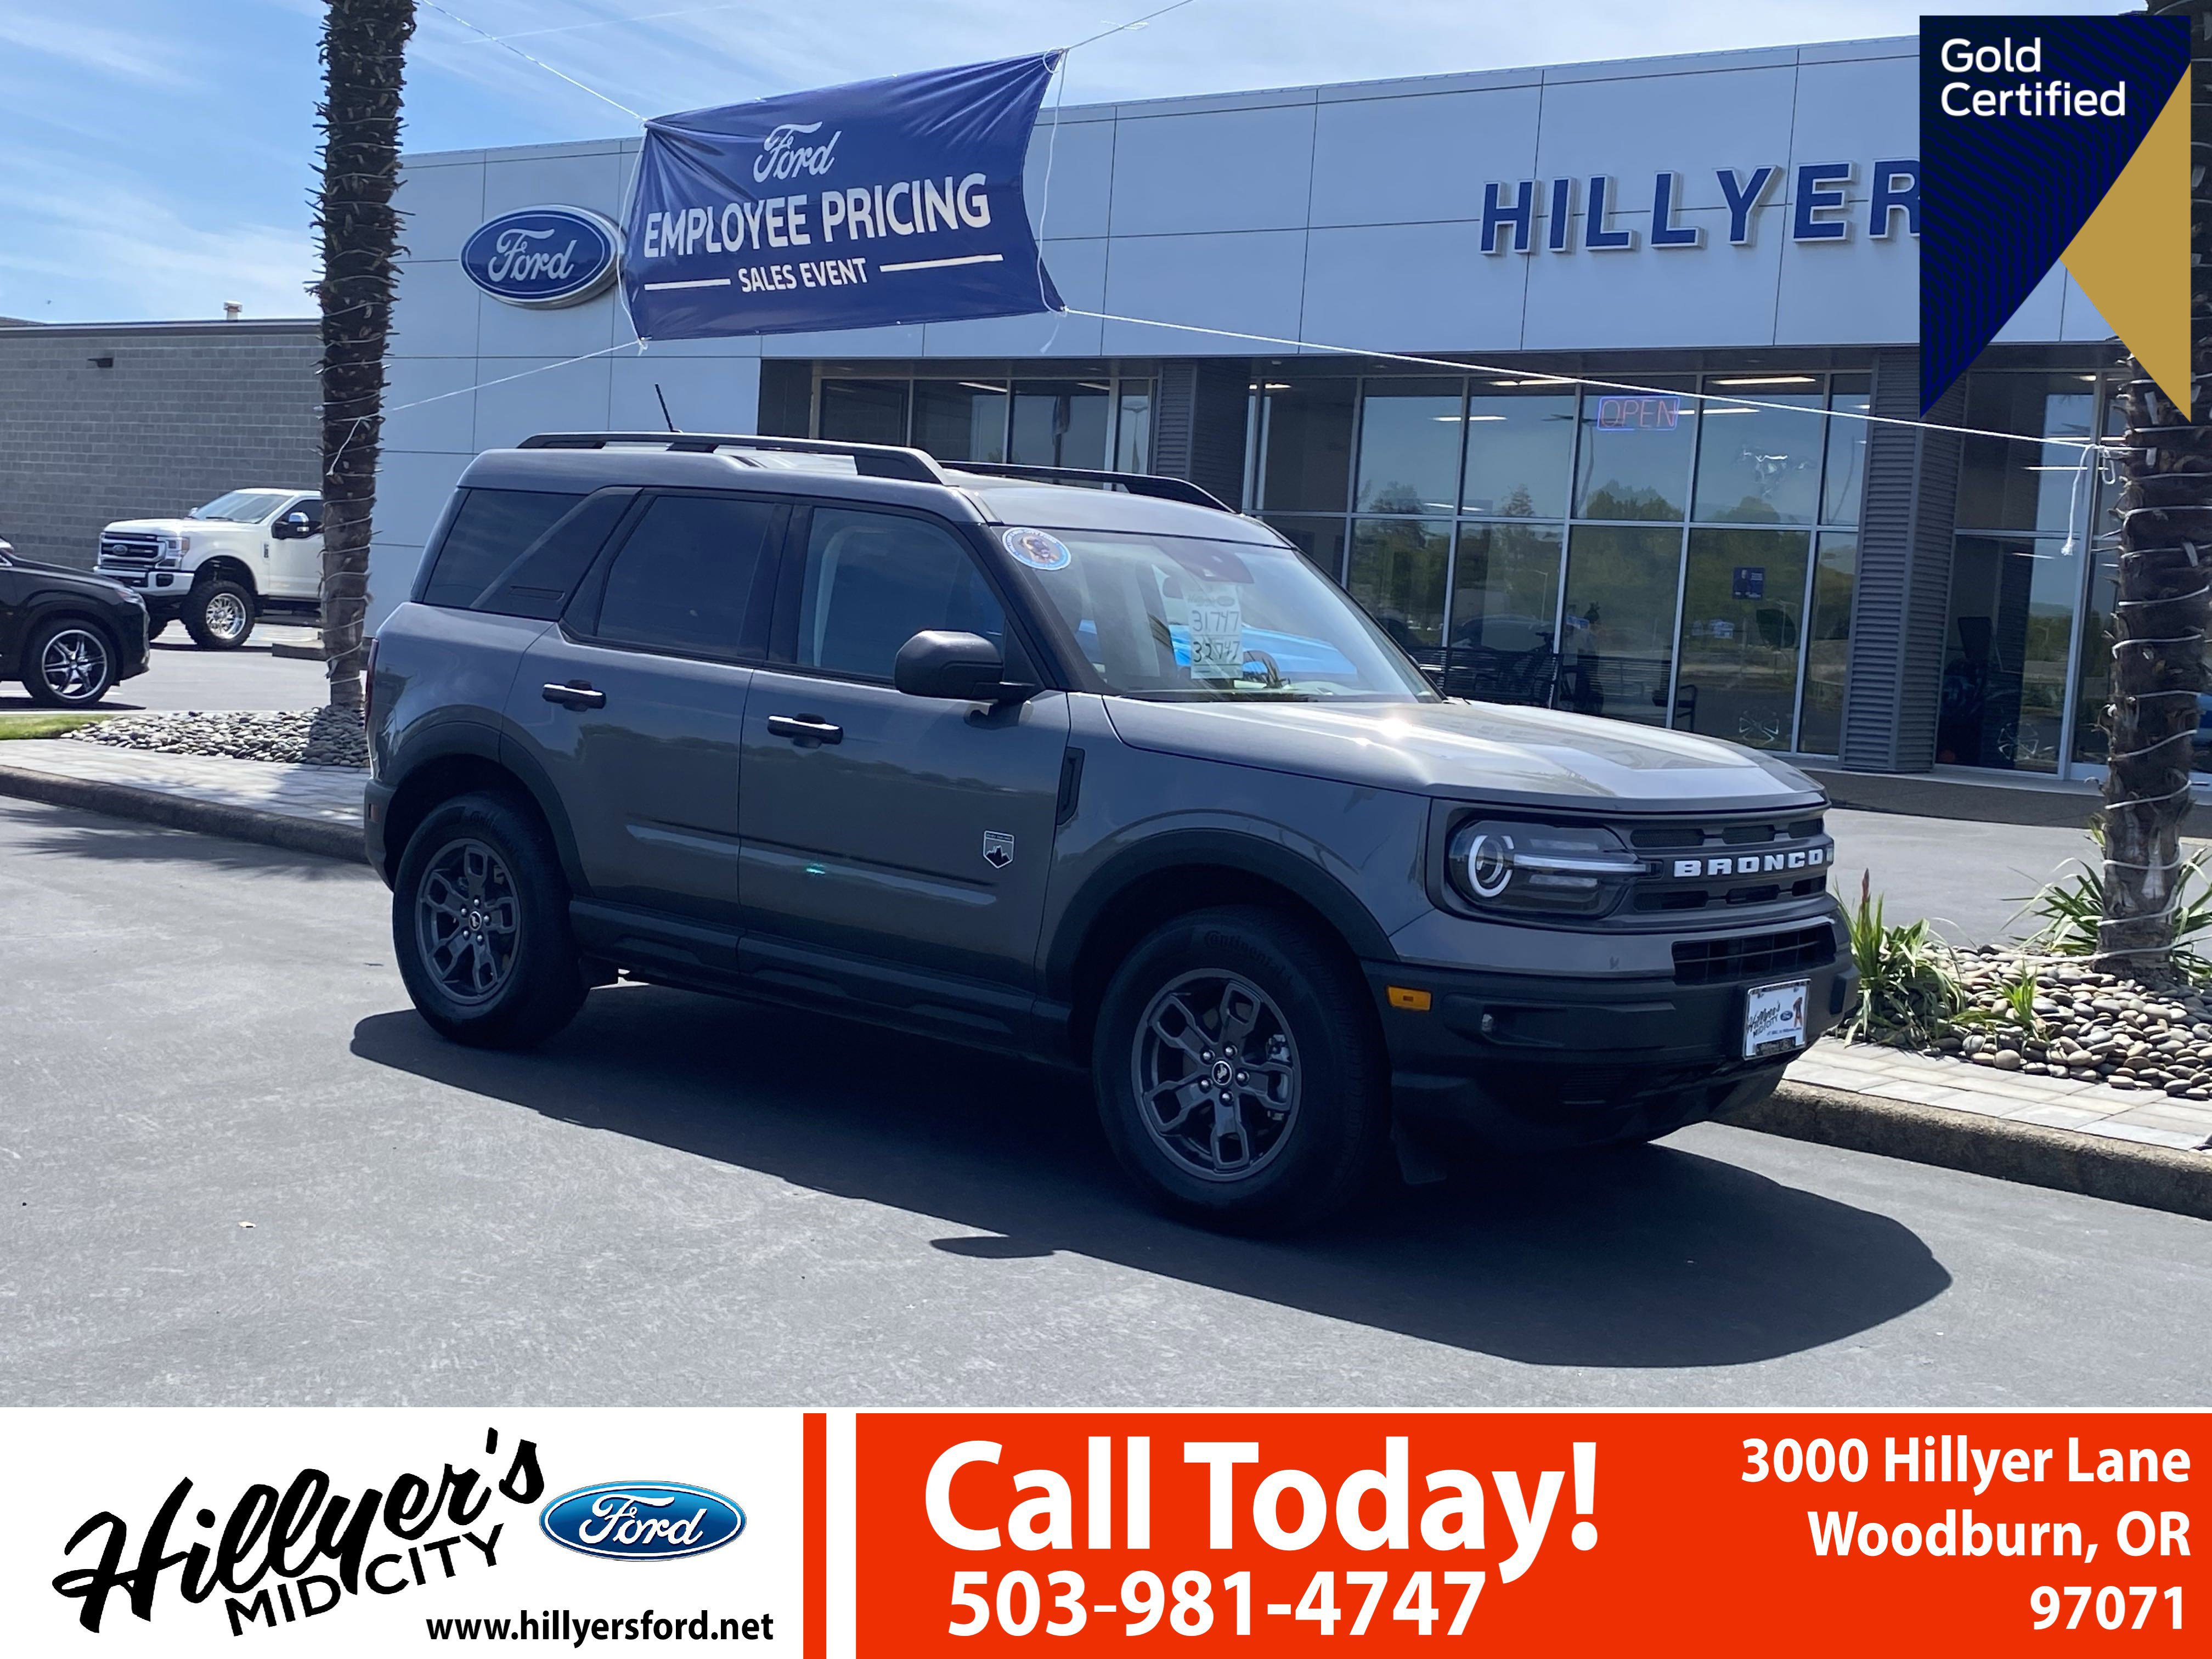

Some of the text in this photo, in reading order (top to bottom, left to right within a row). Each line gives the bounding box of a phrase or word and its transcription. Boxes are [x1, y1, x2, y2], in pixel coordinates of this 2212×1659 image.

[753, 121, 842, 183] Ford
[644, 172, 991, 258] EMPLOYEE PRICING
[1480, 157, 1920, 255] HILLYER
[488, 228, 577, 281] Ford
[738, 257, 868, 293] SALES EVENT
[1601, 399, 1677, 427] OPEN
[1674, 849, 1823, 877] BRONCO
